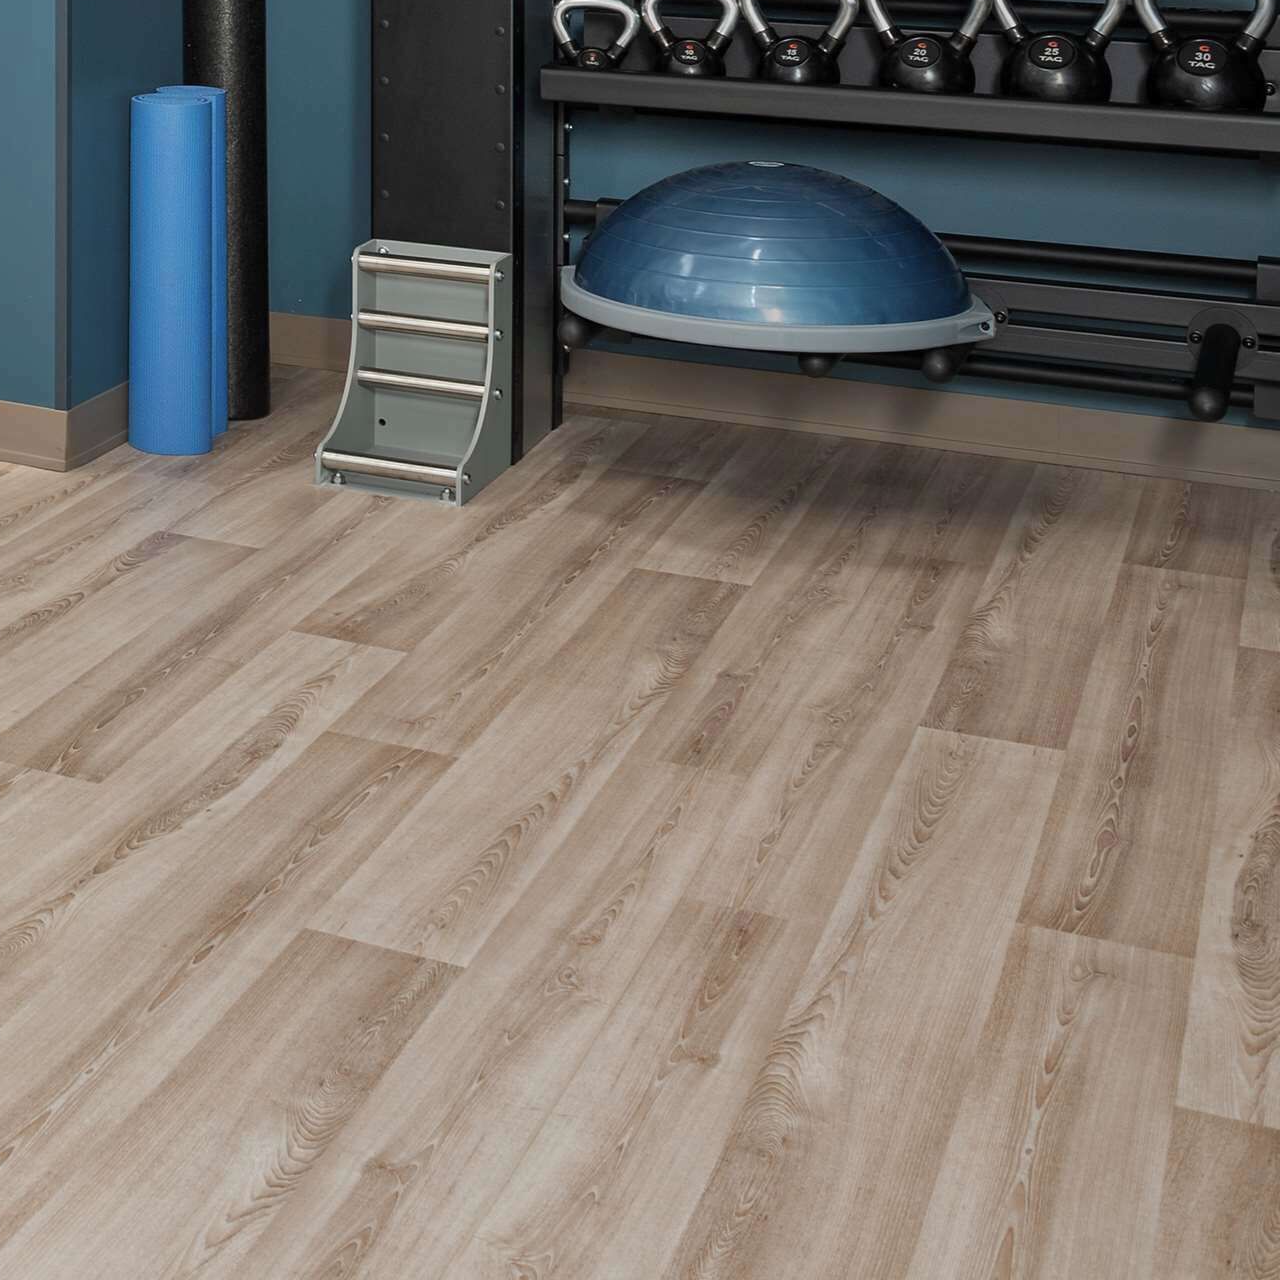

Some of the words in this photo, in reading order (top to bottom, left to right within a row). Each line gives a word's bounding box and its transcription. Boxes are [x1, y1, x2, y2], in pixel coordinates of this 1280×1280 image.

[913, 48, 927, 56] 20
[1044, 47, 1060, 56] 25
[1039, 55, 1063, 63] TAG
[1194, 52, 1211, 61] 30
[1188, 60, 1216, 69] TAG
